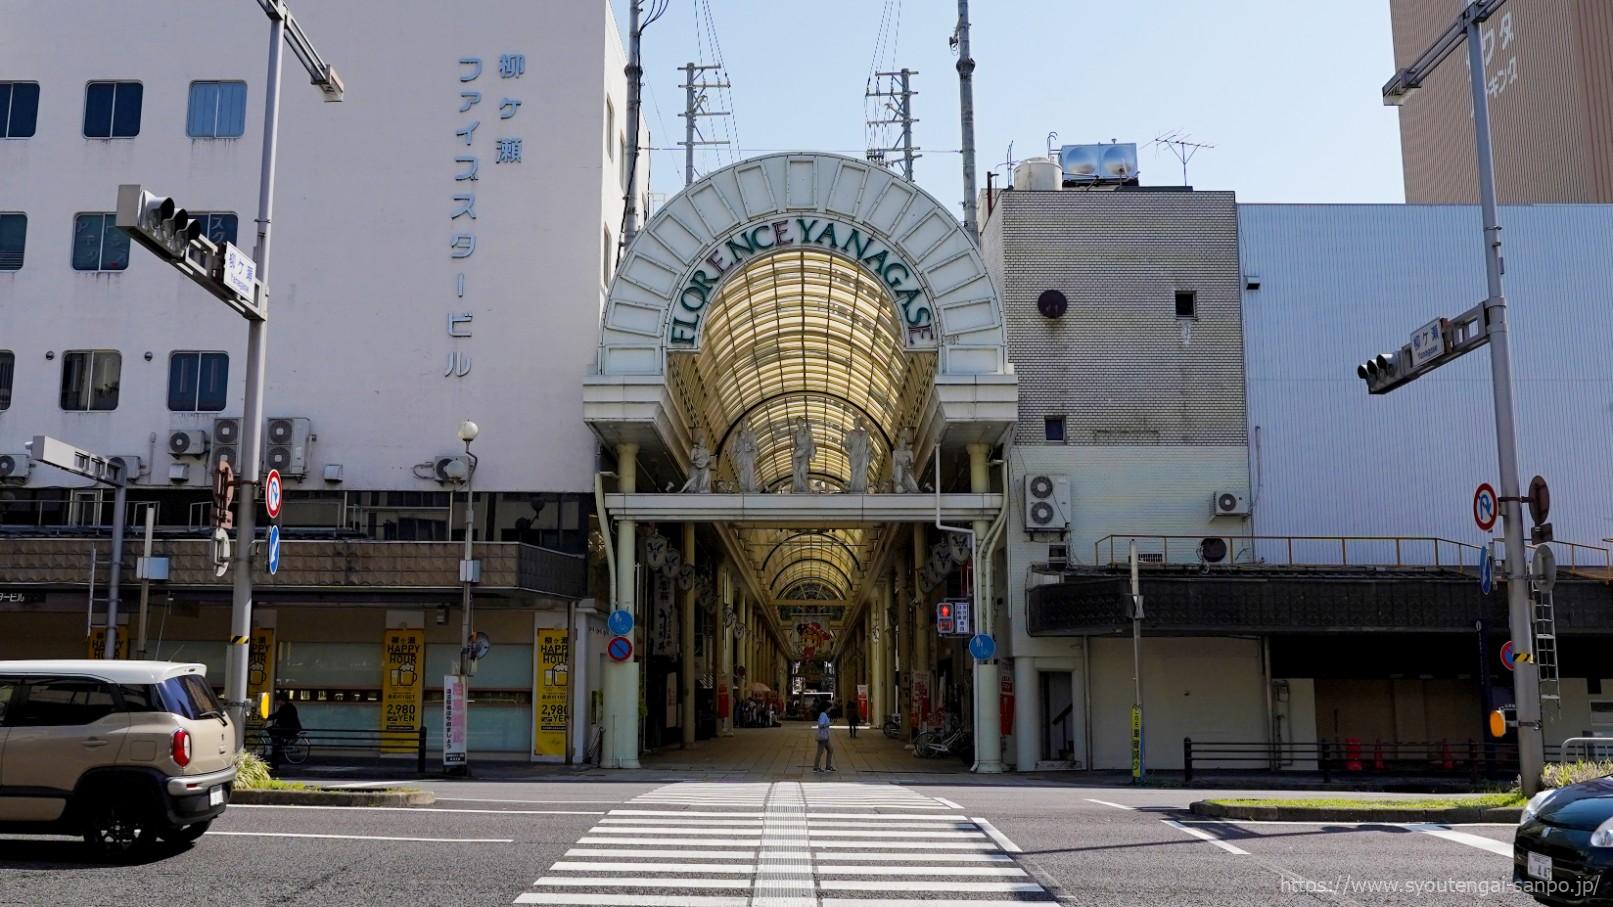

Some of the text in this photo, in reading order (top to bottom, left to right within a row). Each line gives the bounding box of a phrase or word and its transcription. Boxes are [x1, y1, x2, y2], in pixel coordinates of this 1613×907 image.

[671, 218, 935, 346] FLORENCE YANAGASE
[387, 644, 420, 653] HAPPY
[540, 644, 568, 653] HAPP
[389, 654, 416, 664] HOUR
[387, 704, 416, 715] 2,980
